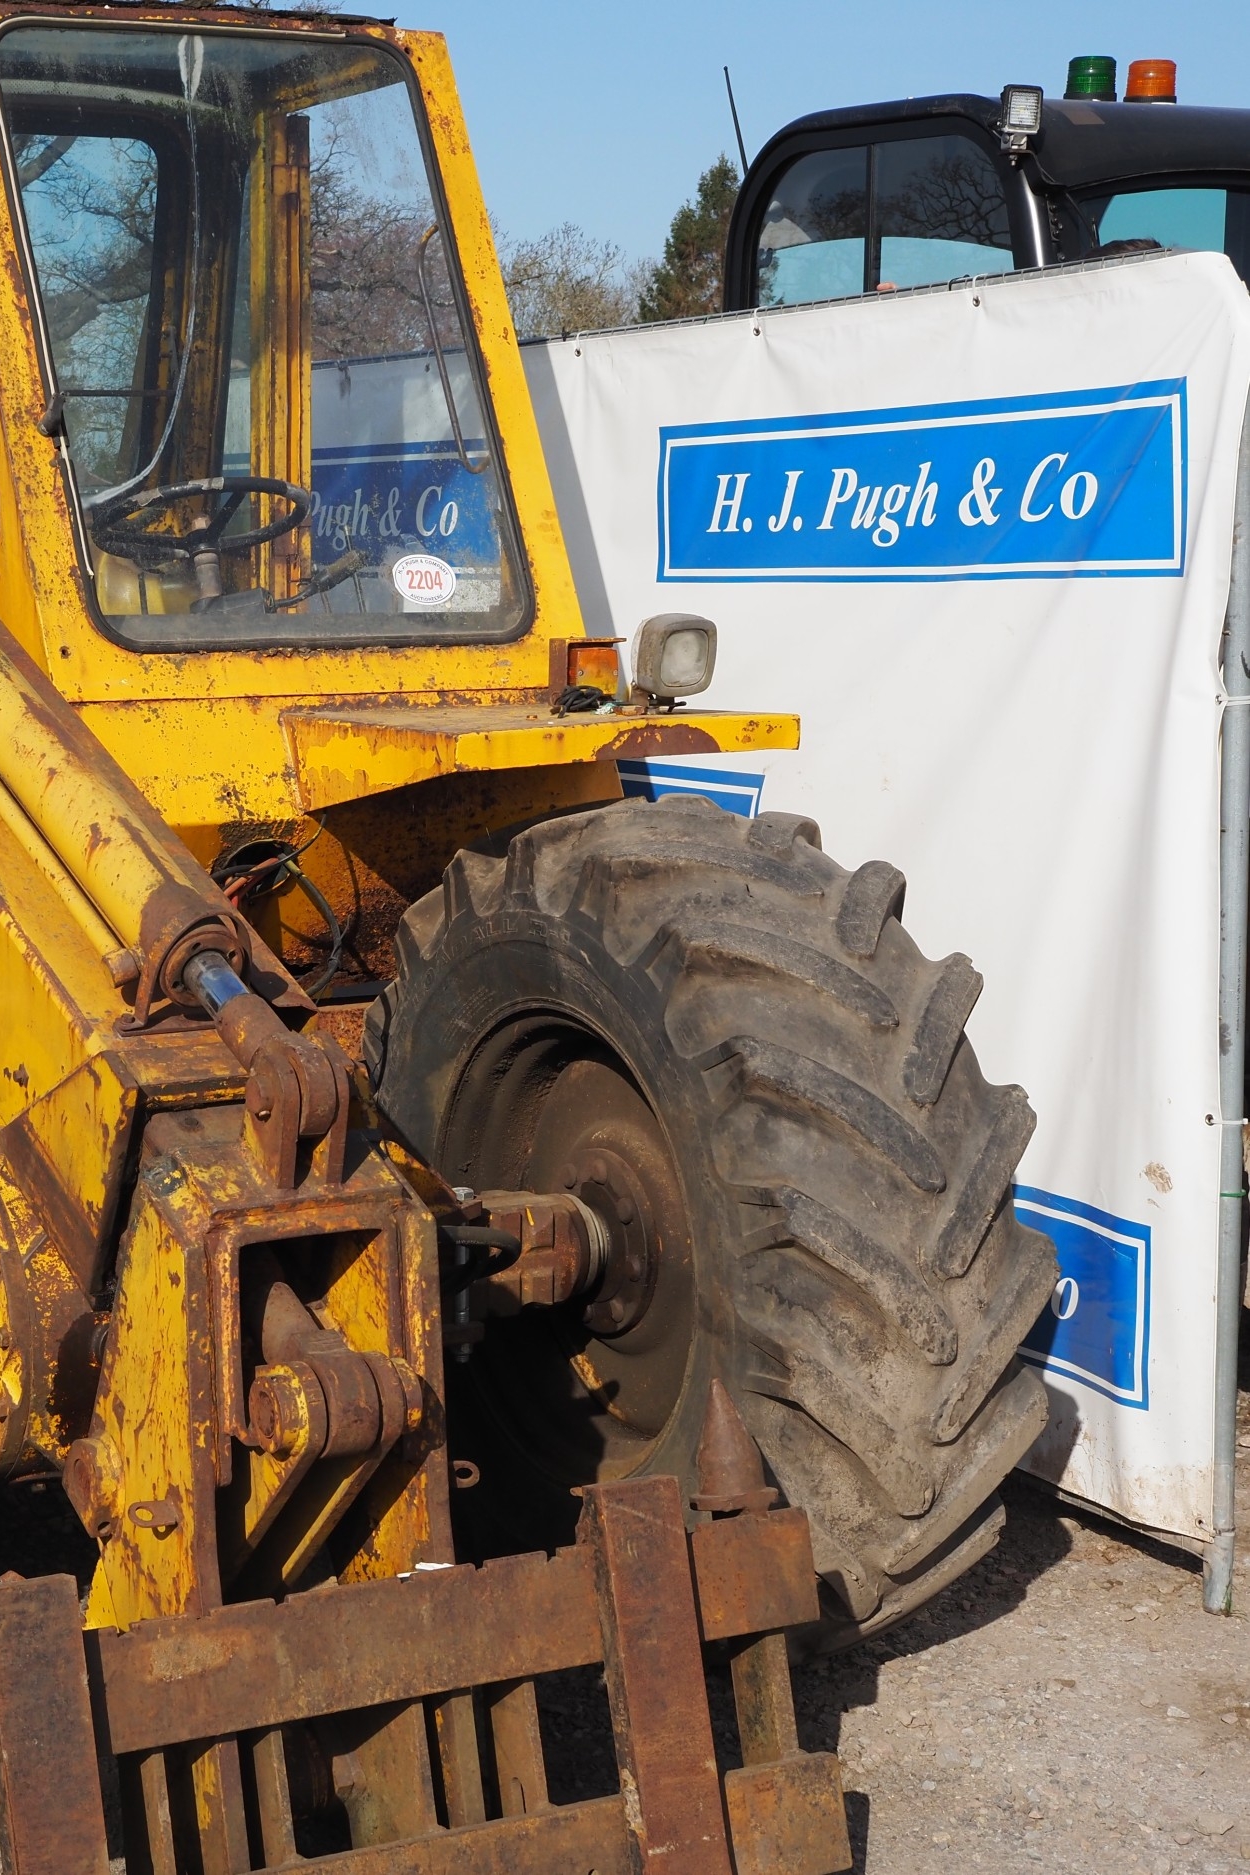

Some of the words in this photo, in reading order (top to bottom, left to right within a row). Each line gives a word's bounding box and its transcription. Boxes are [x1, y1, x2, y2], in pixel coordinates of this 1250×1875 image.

[379, 486, 403, 537] &
[416, 485, 459, 537] Co
[706, 473, 753, 533] H.
[768, 470, 803, 532] J.
[816, 461, 938, 547] Pugh
[958, 457, 1003, 527] &
[1020, 452, 1098, 522] Co
[406, 569, 443, 591] 2204
[425, 559, 449, 575] COMPANY
